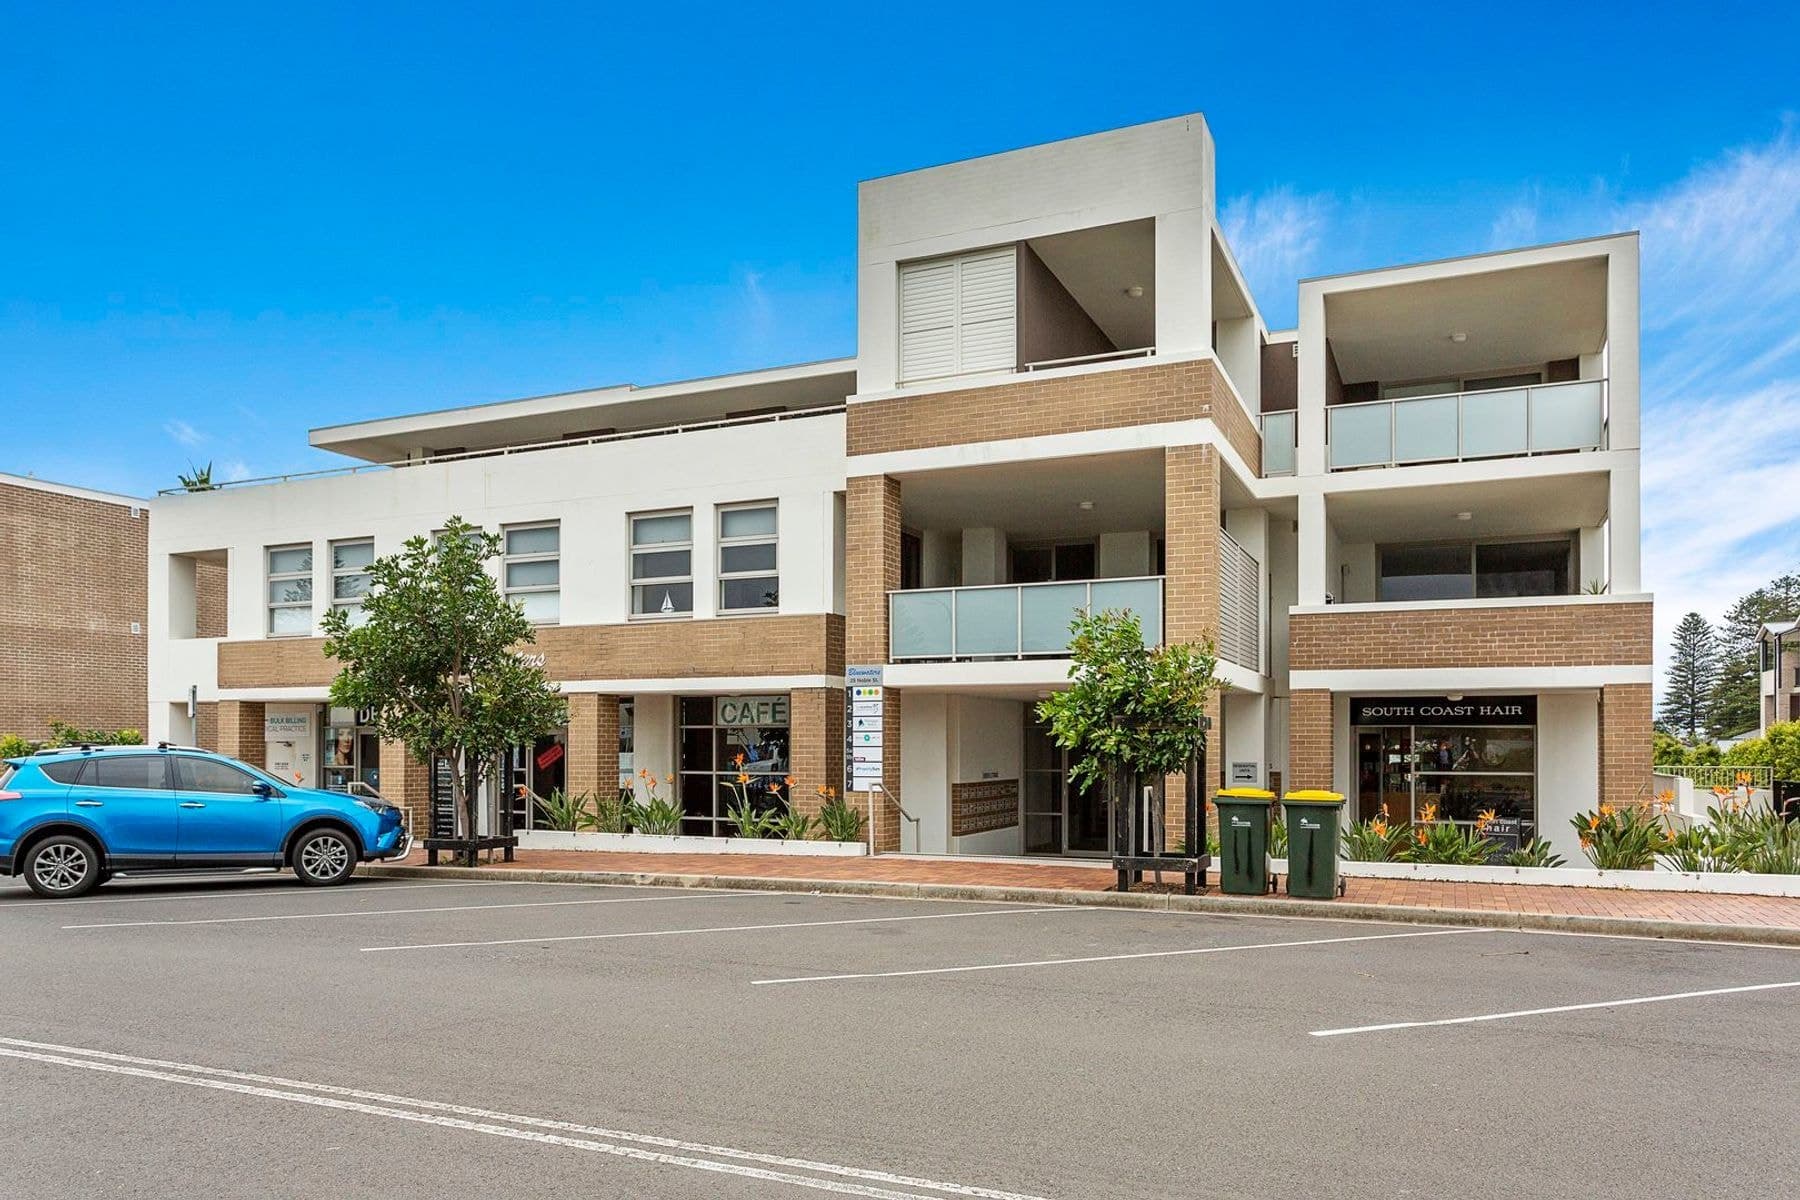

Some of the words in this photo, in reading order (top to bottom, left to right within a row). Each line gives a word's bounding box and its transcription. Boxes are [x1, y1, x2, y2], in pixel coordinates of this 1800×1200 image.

[721, 697, 787, 724] CAFÉ
[847, 705, 852, 713] 2
[1362, 706, 1415, 717] SOUTH
[1420, 706, 1475, 716] COAST
[1480, 705, 1523, 716] HAIR
[847, 720, 852, 728] 3
[847, 735, 852, 743] 4
[847, 765, 852, 773] 6
[847, 780, 852, 788] 7
[1487, 824, 1511, 833] hair
